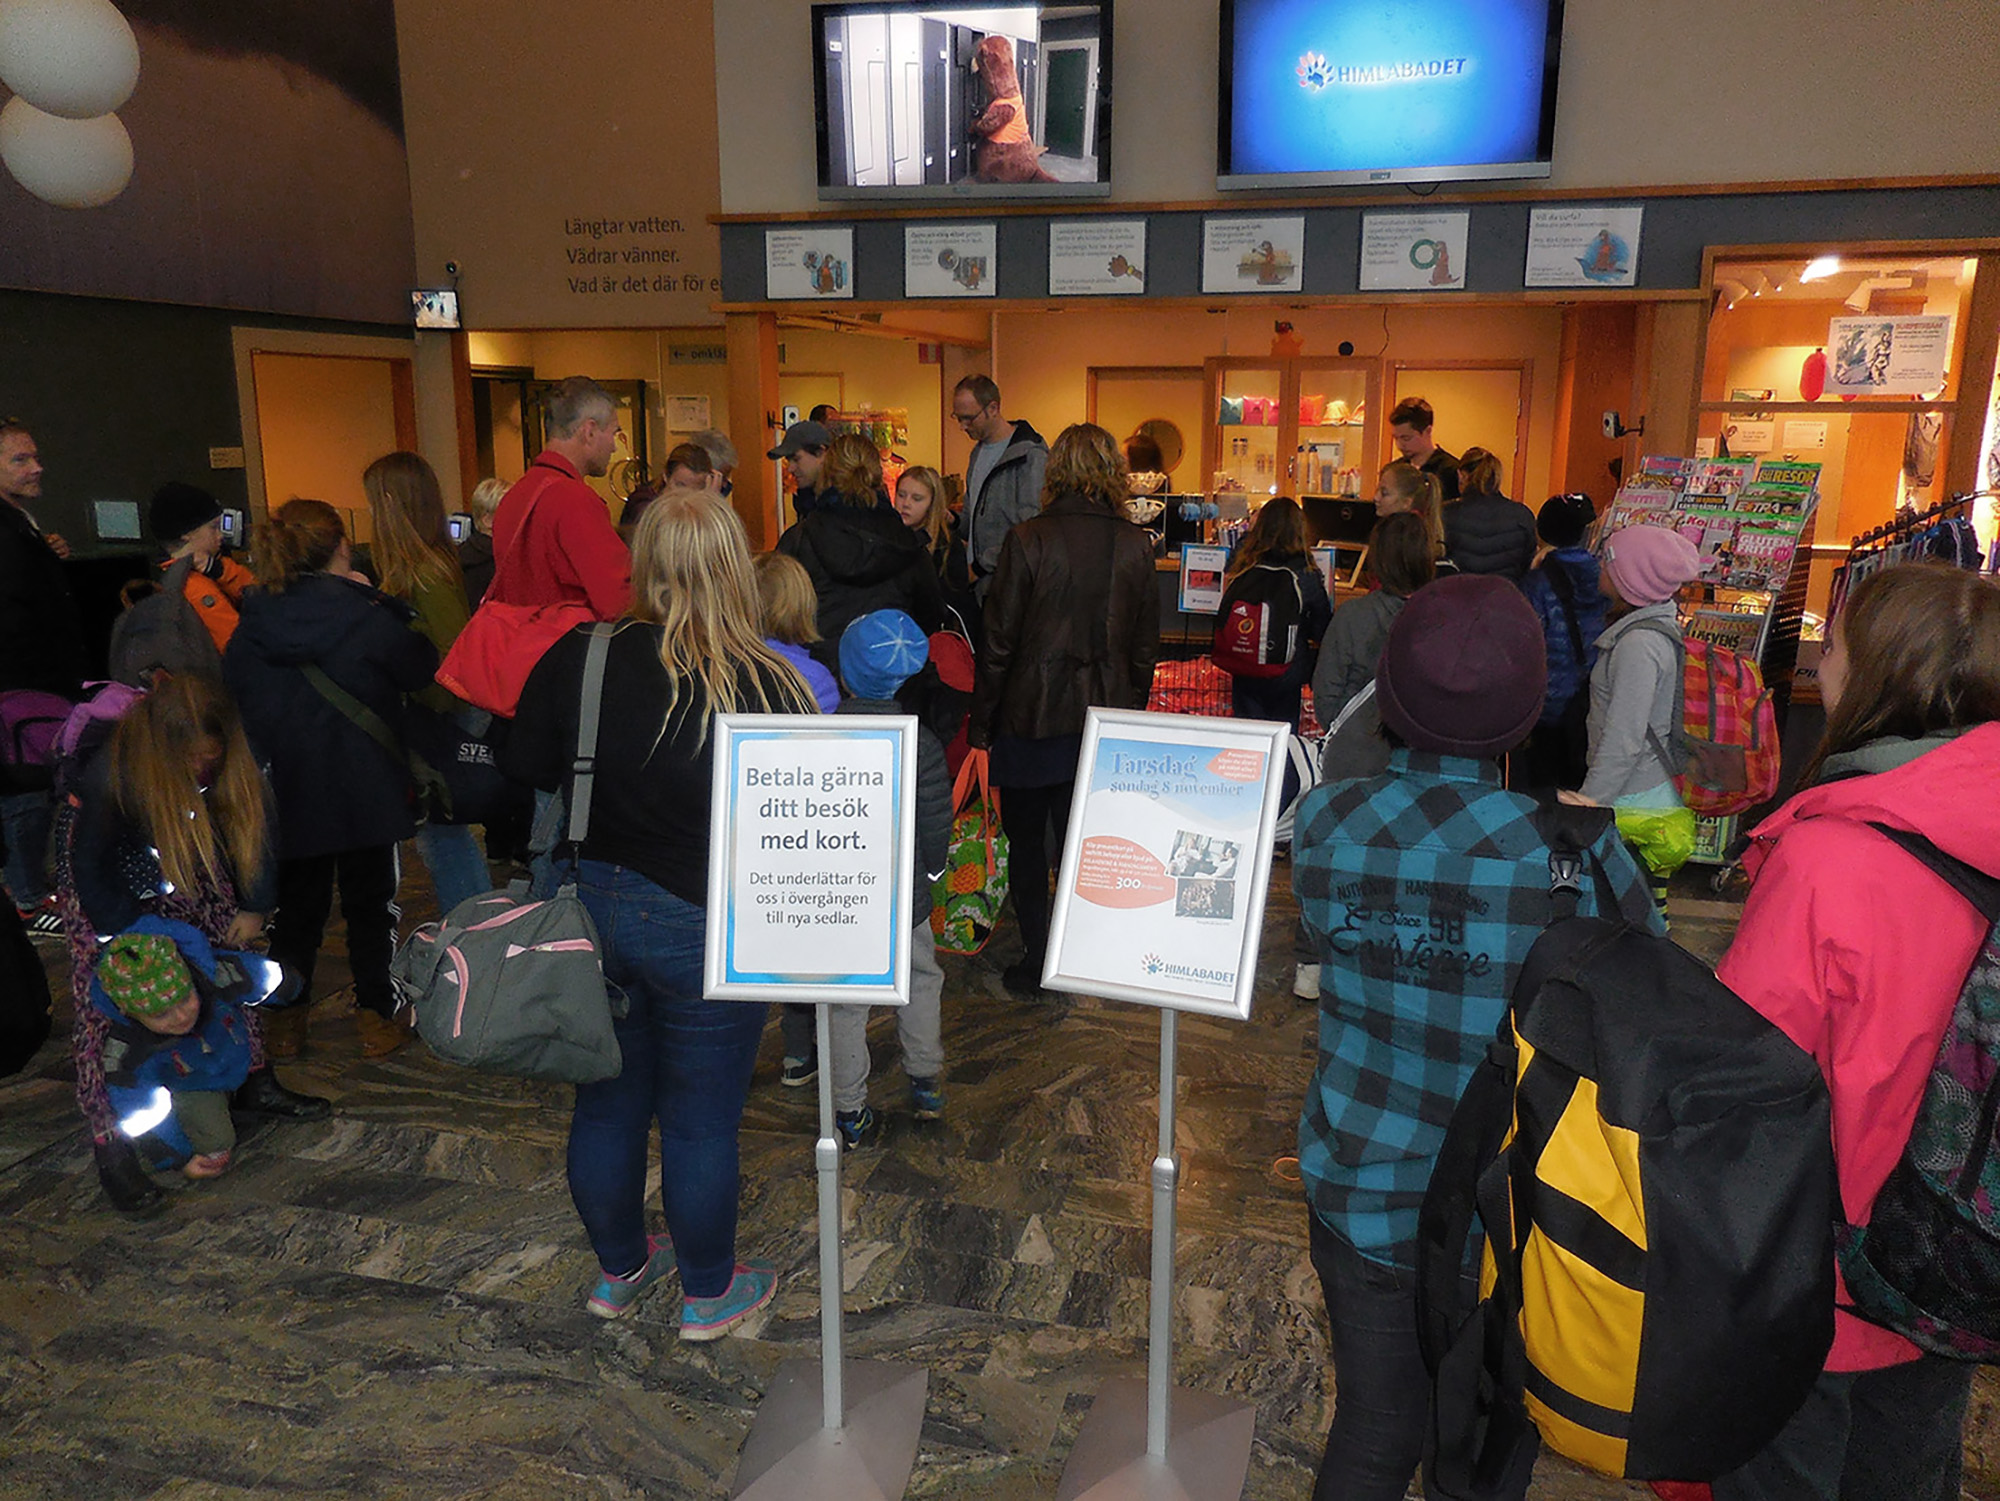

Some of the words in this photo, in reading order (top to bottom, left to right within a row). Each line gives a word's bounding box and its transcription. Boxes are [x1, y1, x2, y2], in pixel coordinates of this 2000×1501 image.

[1337, 57, 1467, 83] HIMLABADET
[564, 217, 624, 239] Längtar
[628, 217, 685, 233] vatten.
[566, 247, 618, 264] Vädrar
[622, 247, 680, 263] vänner.
[567, 276, 597, 293] Vad
[602, 276, 618, 293] är
[622, 276, 648, 292] det
[652, 274, 677, 292] där
[683, 274, 705, 291] för
[1774, 469, 1816, 482] RESOR
[1737, 543, 1773, 556] FRITT
[746, 766, 814, 787] Betala
[821, 766, 884, 792] gärna
[1162, 781, 1171, 794] 8
[1175, 782, 1244, 797] november
[759, 798, 798, 818] ditt
[805, 798, 869, 818] besök
[760, 830, 808, 850] med
[816, 830, 867, 850] kort.
[749, 872, 773, 886] Det
[777, 872, 853, 886] underlättar
[857, 872, 877, 886] för
[1115, 877, 1141, 890] 300
[756, 894, 778, 905] oss
[781, 892, 785, 904] i
[788, 891, 868, 909] övergången
[766, 911, 784, 925] till
[787, 914, 811, 928] nya
[814, 910, 858, 925] sedlar.
[1378, 903, 1422, 927] Since
[1429, 913, 1464, 944] 98
[1164, 963, 1235, 983] HIMLABADET
